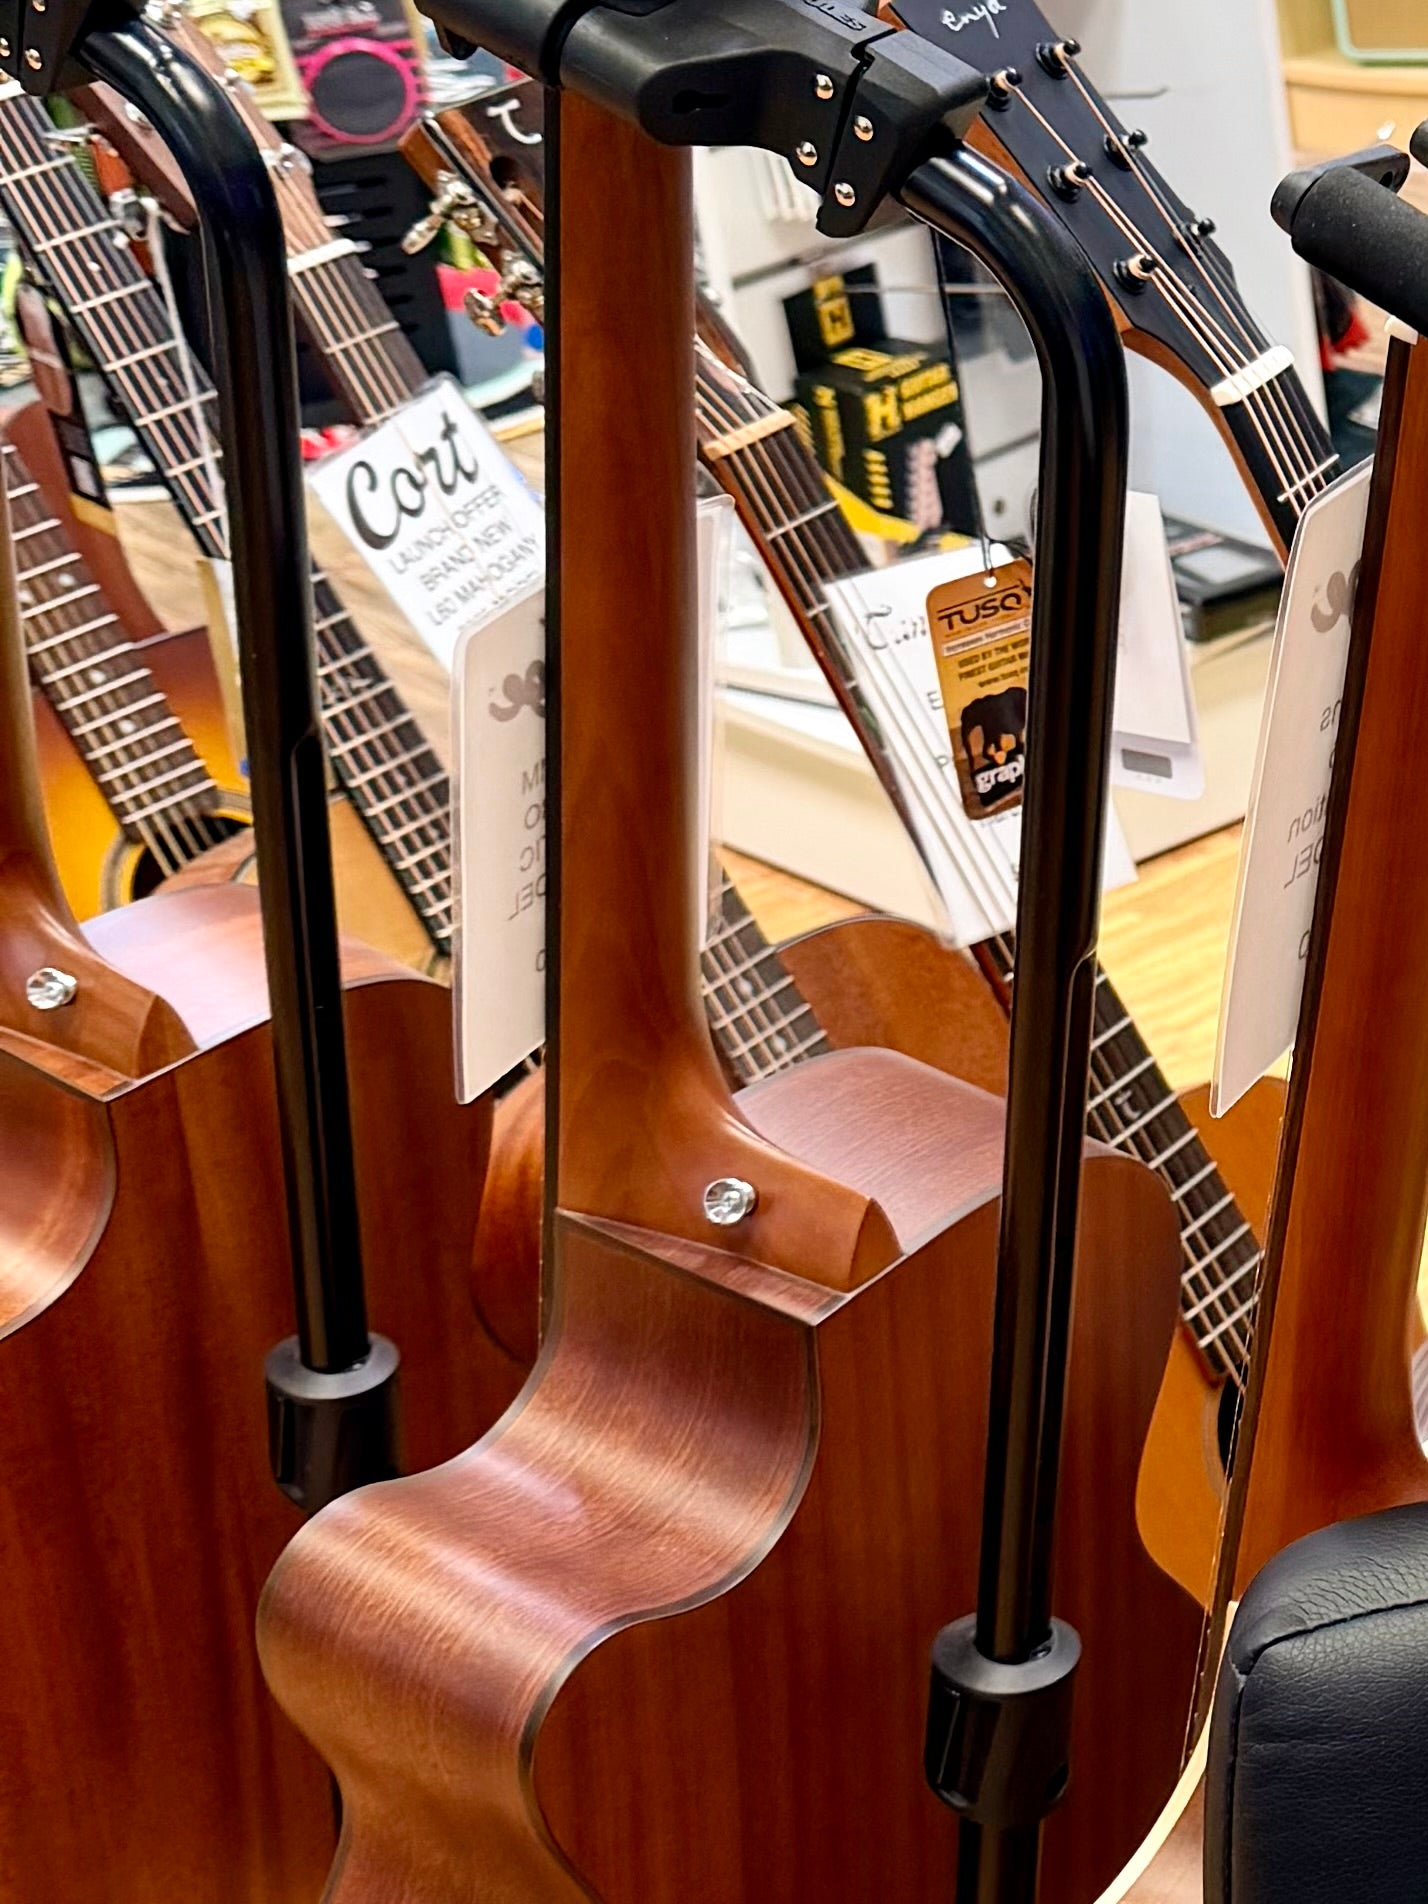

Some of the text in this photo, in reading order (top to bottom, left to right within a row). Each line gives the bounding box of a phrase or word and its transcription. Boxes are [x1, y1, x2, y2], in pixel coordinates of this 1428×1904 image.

[346, 411, 479, 550] Cort
[450, 482, 503, 530] OFFER
[418, 519, 512, 593] BRAND NEW
